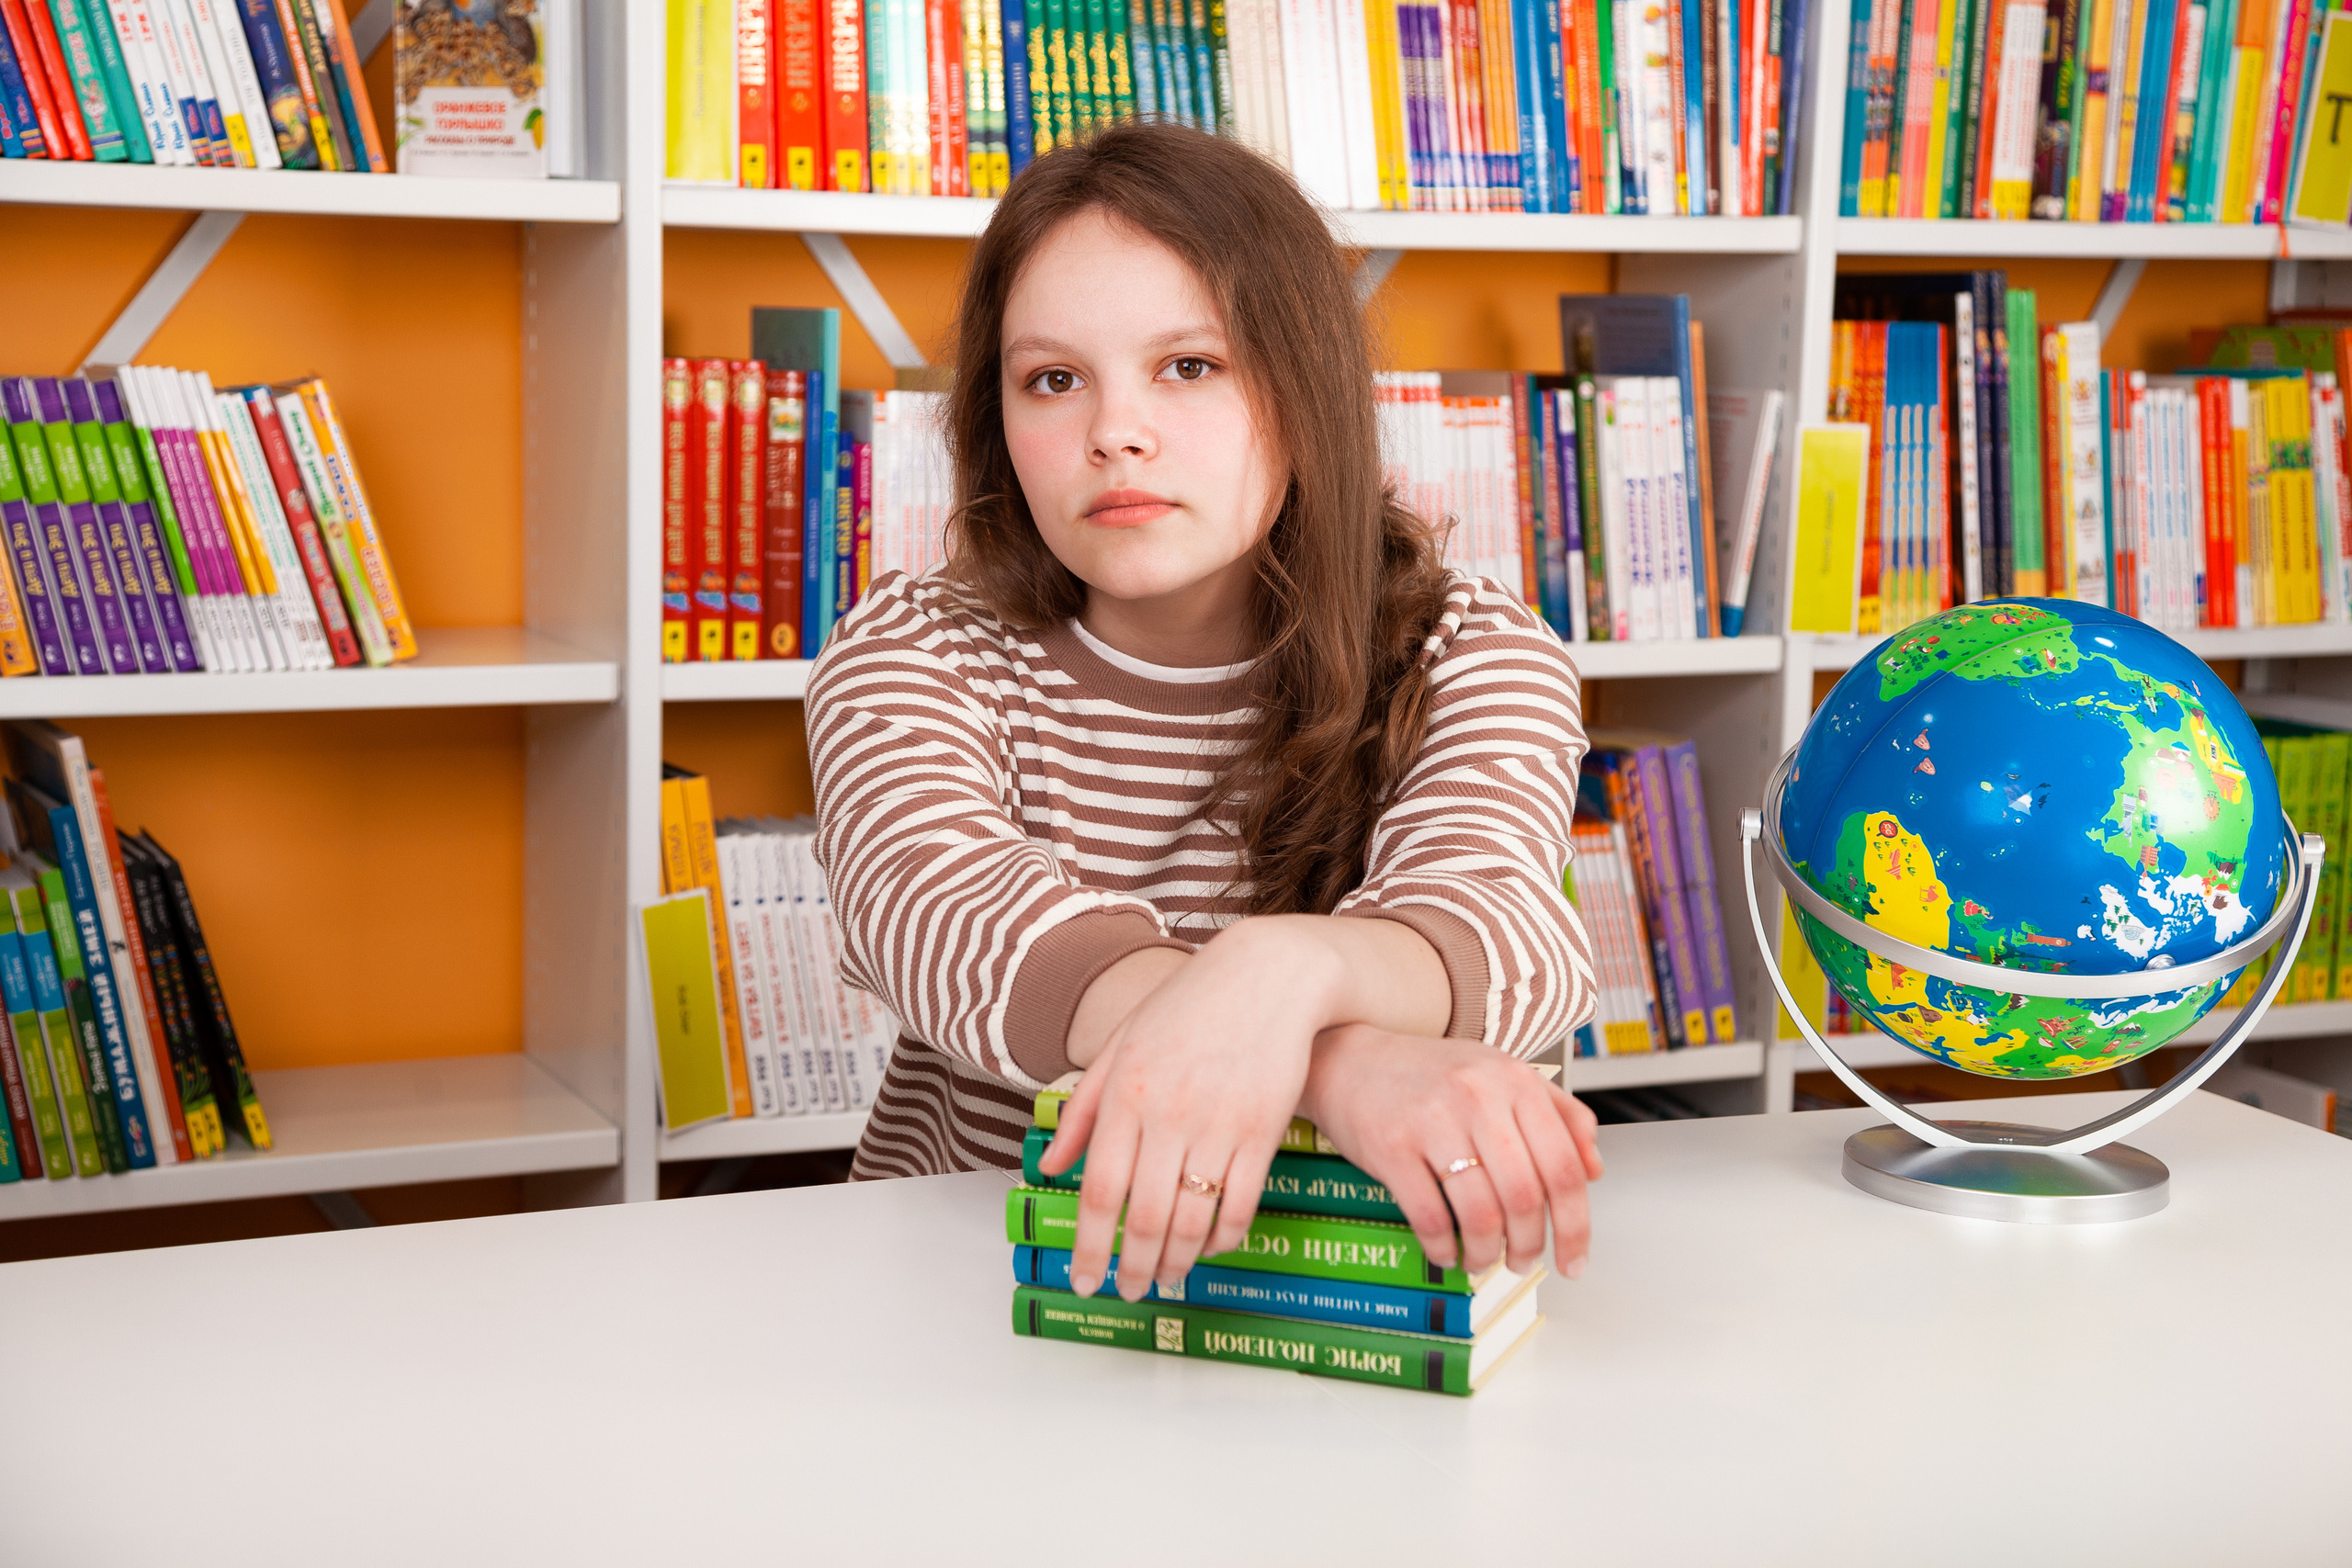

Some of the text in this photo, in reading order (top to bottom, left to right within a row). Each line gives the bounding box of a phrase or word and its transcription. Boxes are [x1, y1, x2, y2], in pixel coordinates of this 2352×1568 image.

[74, 908, 104, 968] ЗМЕЙ
[90, 970, 137, 1104] БУМАЖНЫЙ
[1266, 1177, 1393, 1205] ЕКСАНДР КУП
[1237, 1234, 1408, 1269] ДЖЕЙН ОСТ
[1207, 1280, 1408, 1318] КОНСТАНТИН ПАУСТОВСКИЙ
[1044, 1308, 1086, 1326] ЧЕЛОВЕКЕ
[1078, 1325, 1114, 1339] ПОВЕСТЬ
[1086, 1314, 1136, 1330] НАСТОЯЩЕМ
[1204, 1330, 1402, 1376] БОРИС ПОЛЕВОЙ
